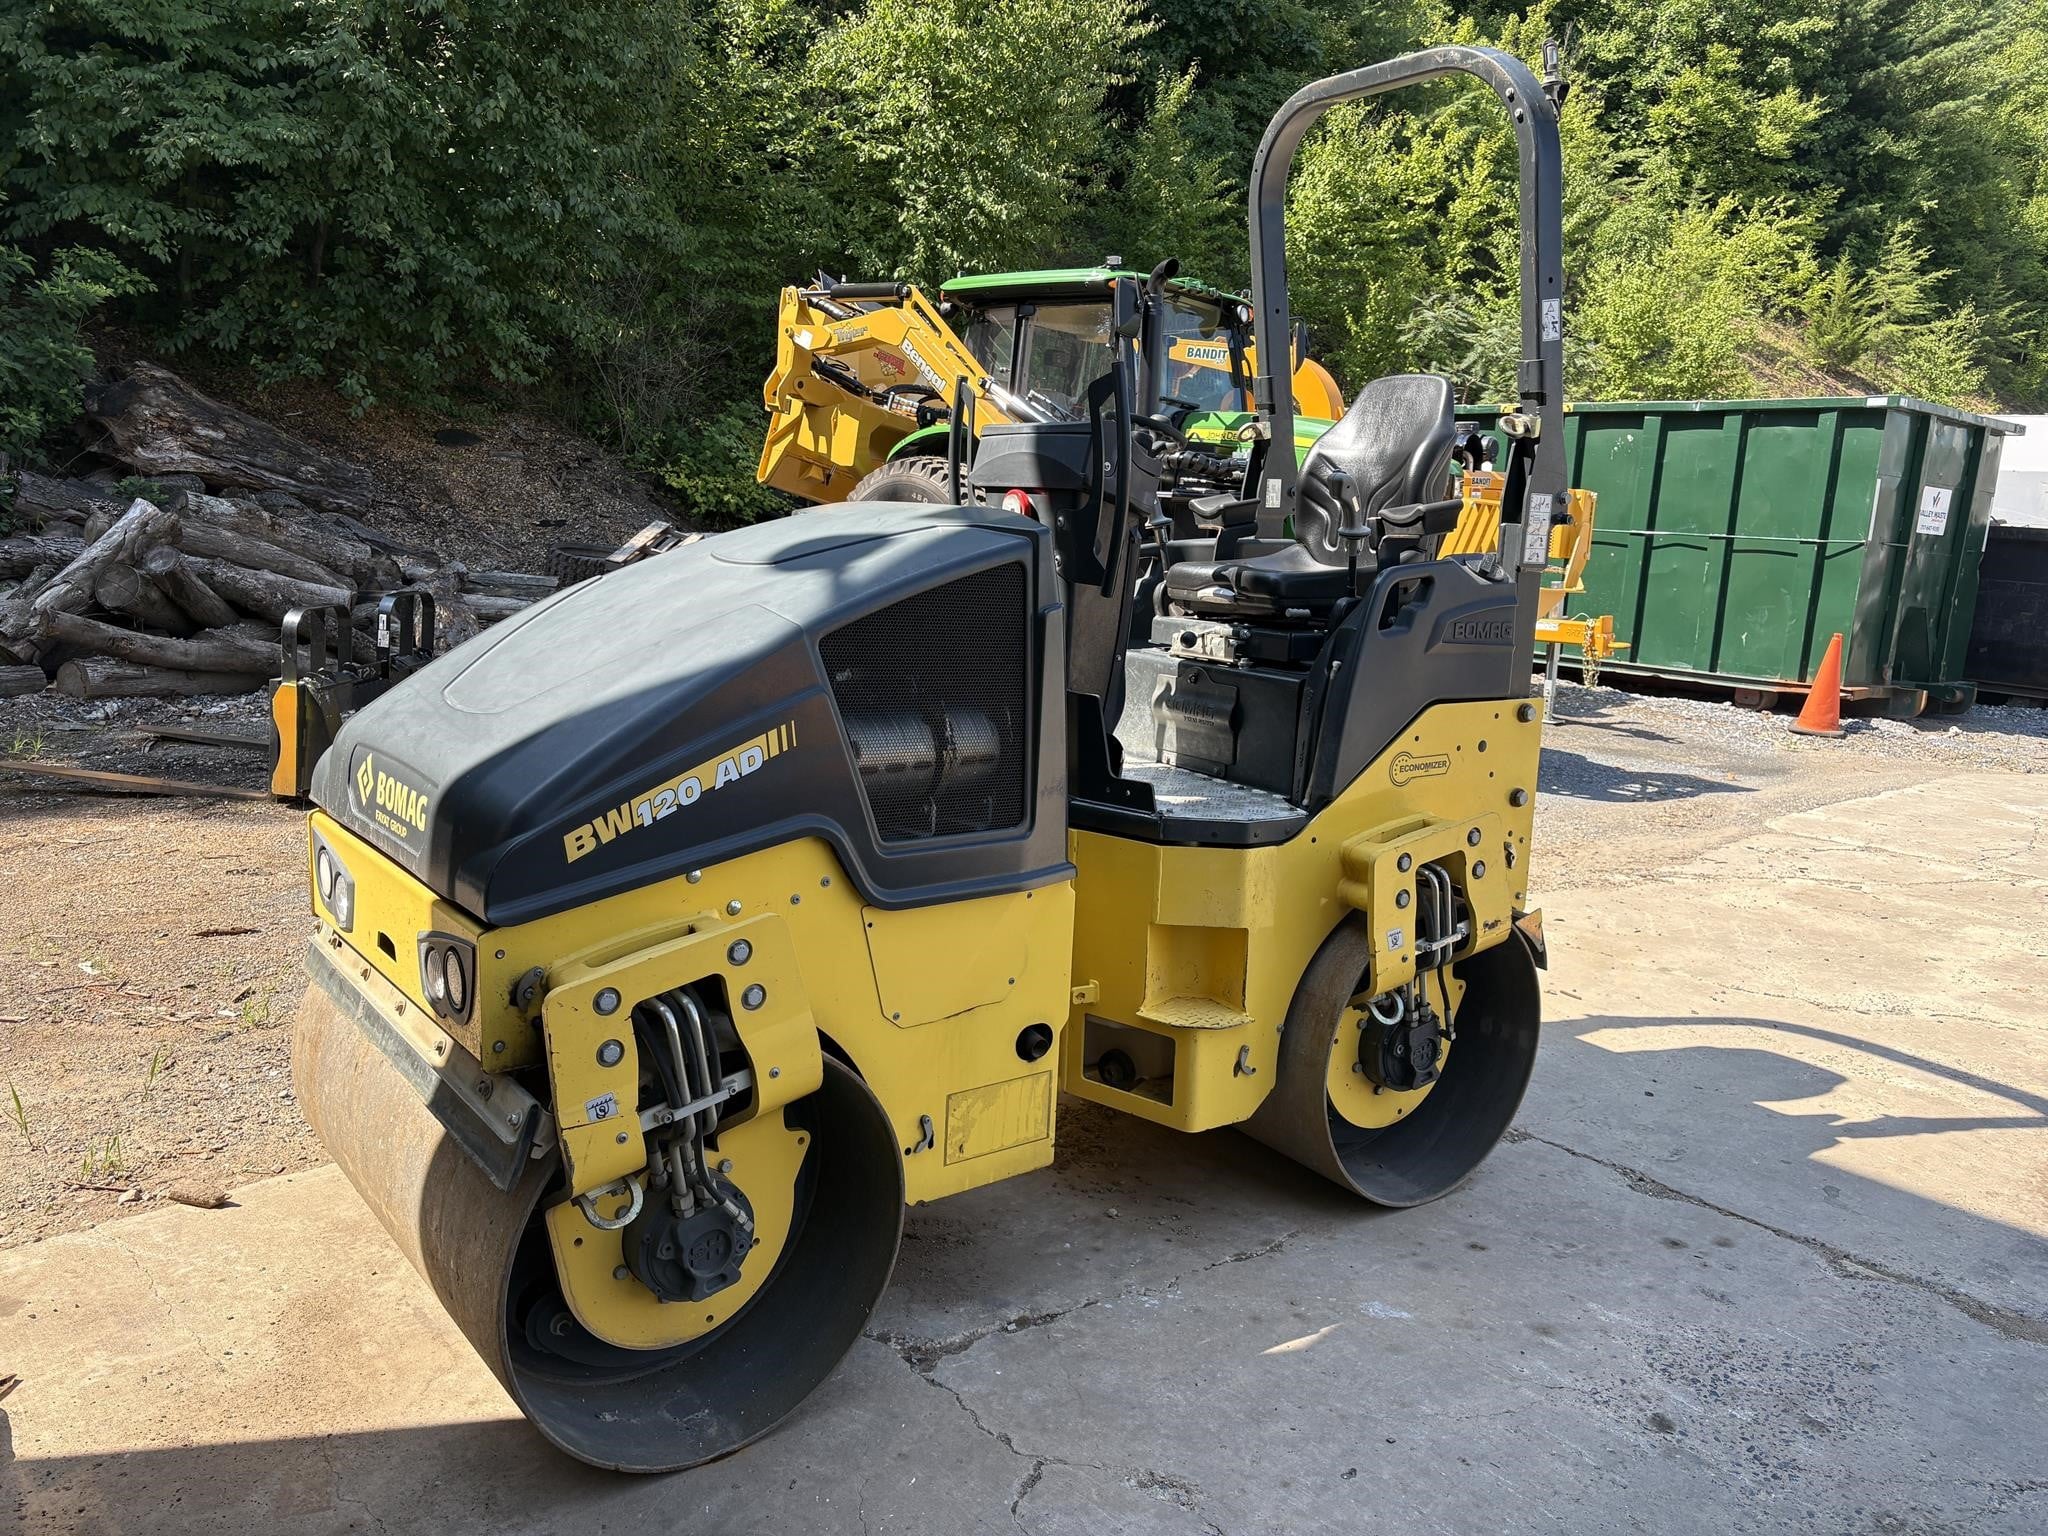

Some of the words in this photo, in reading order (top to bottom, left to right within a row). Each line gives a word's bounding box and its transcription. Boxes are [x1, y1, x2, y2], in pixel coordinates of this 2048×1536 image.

[1186, 346, 1228, 361] BANDIT
[901, 337, 948, 394] Bengal
[1471, 477, 1492, 487] BANDIT
[1454, 621, 1513, 640] BOMAG
[714, 745, 765, 791] AD
[1399, 759, 1448, 774] ECONOMIZER
[375, 770, 429, 832] BOMAG
